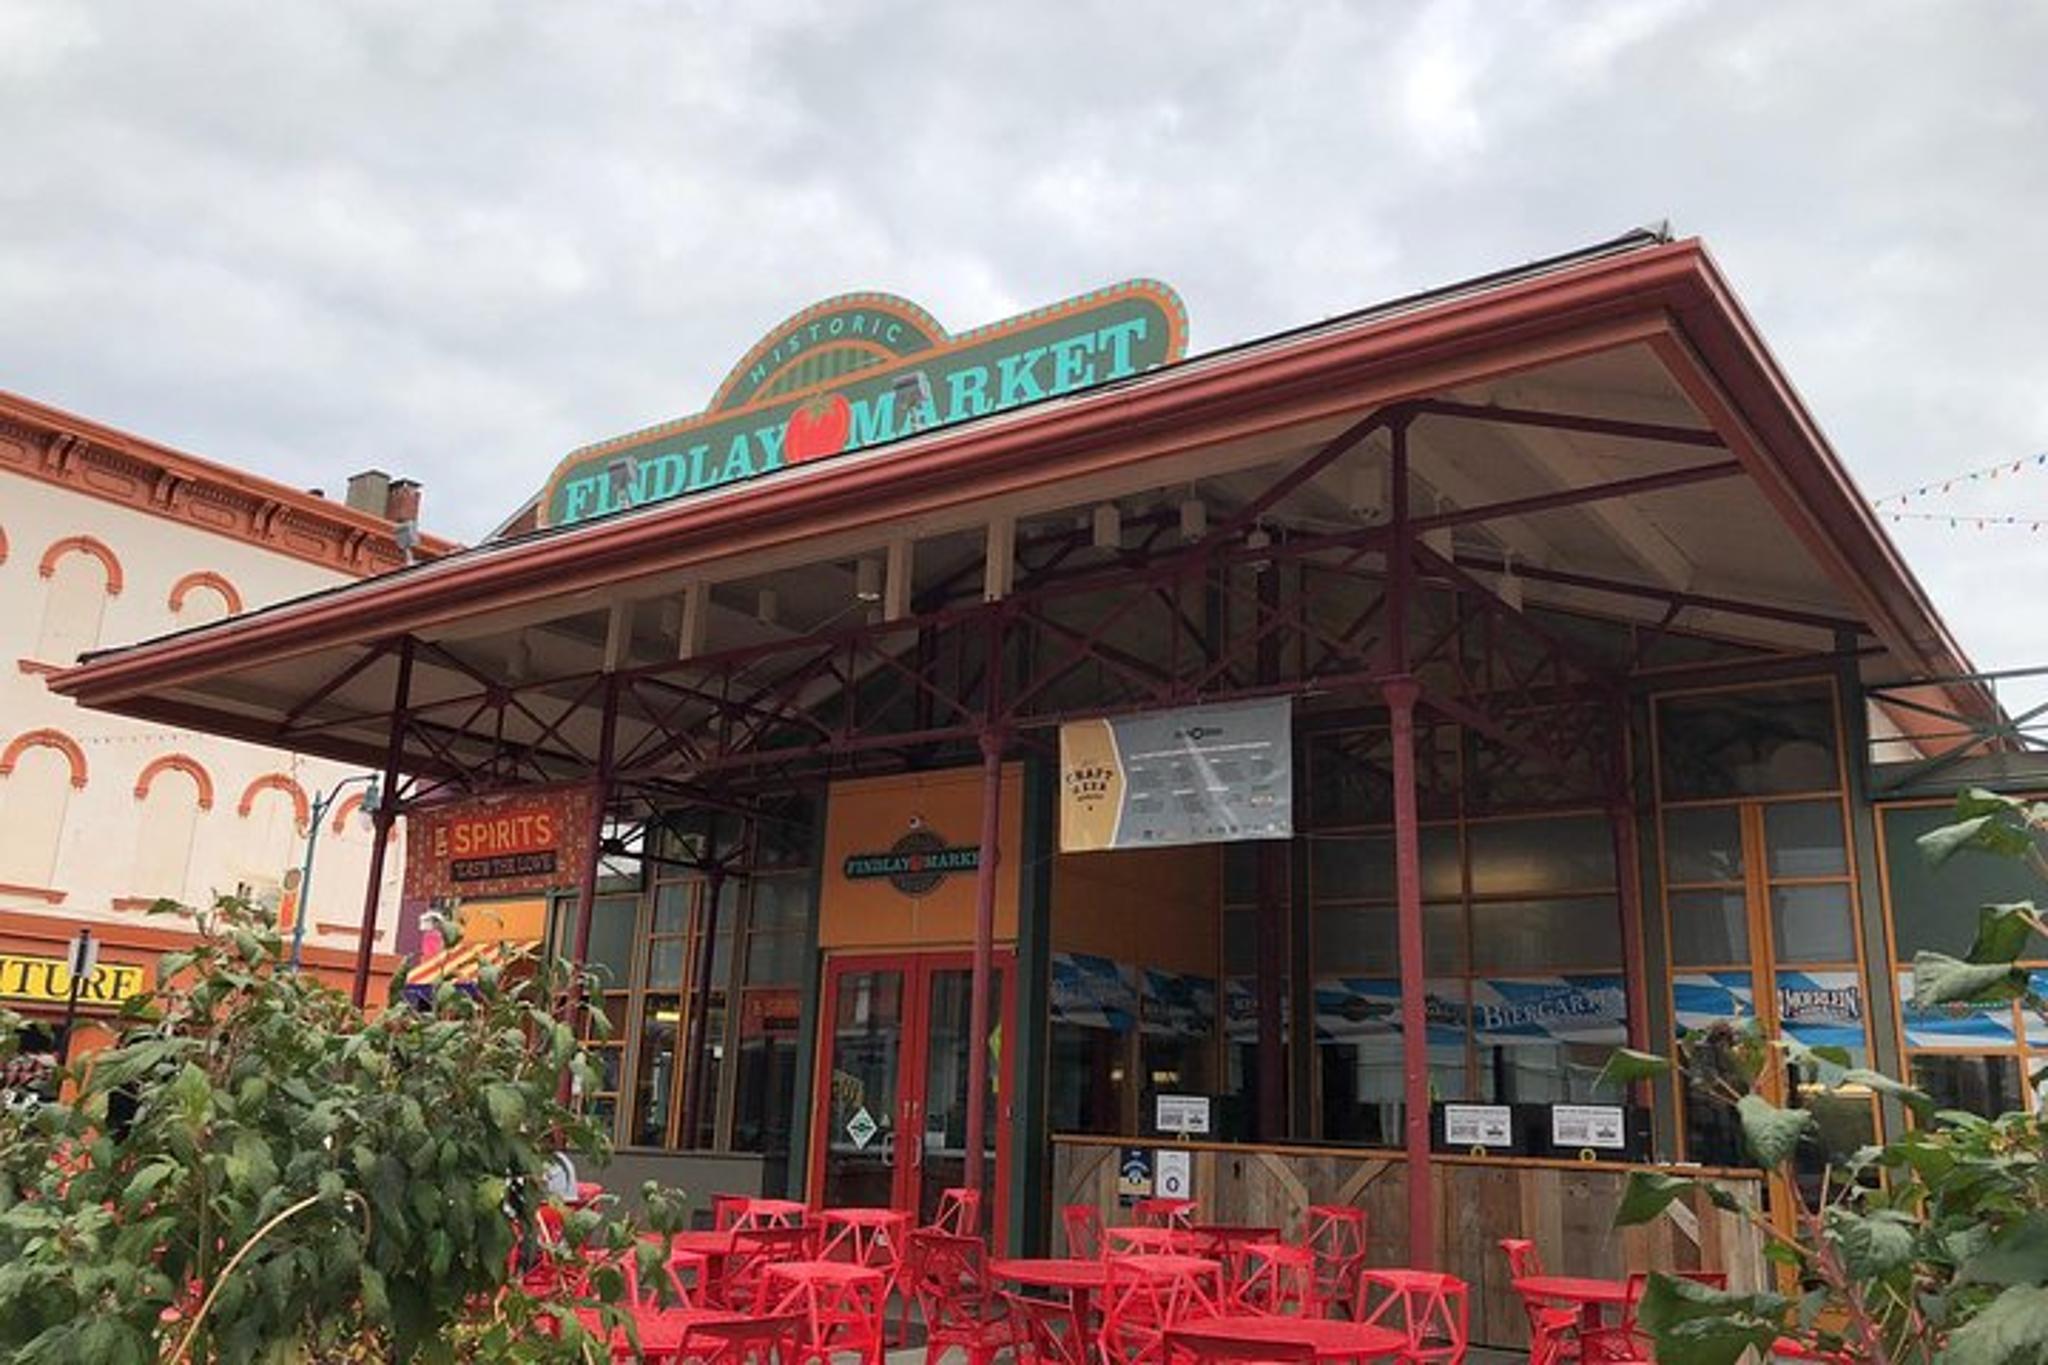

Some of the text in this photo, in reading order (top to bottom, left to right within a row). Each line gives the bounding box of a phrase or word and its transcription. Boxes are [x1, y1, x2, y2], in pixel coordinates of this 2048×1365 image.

[750, 313, 903, 383] HISTORIC
[561, 317, 1147, 525] FINDLAY MARKET
[454, 814, 553, 853] SPIRITS
[925, 852, 982, 870] MARKE
